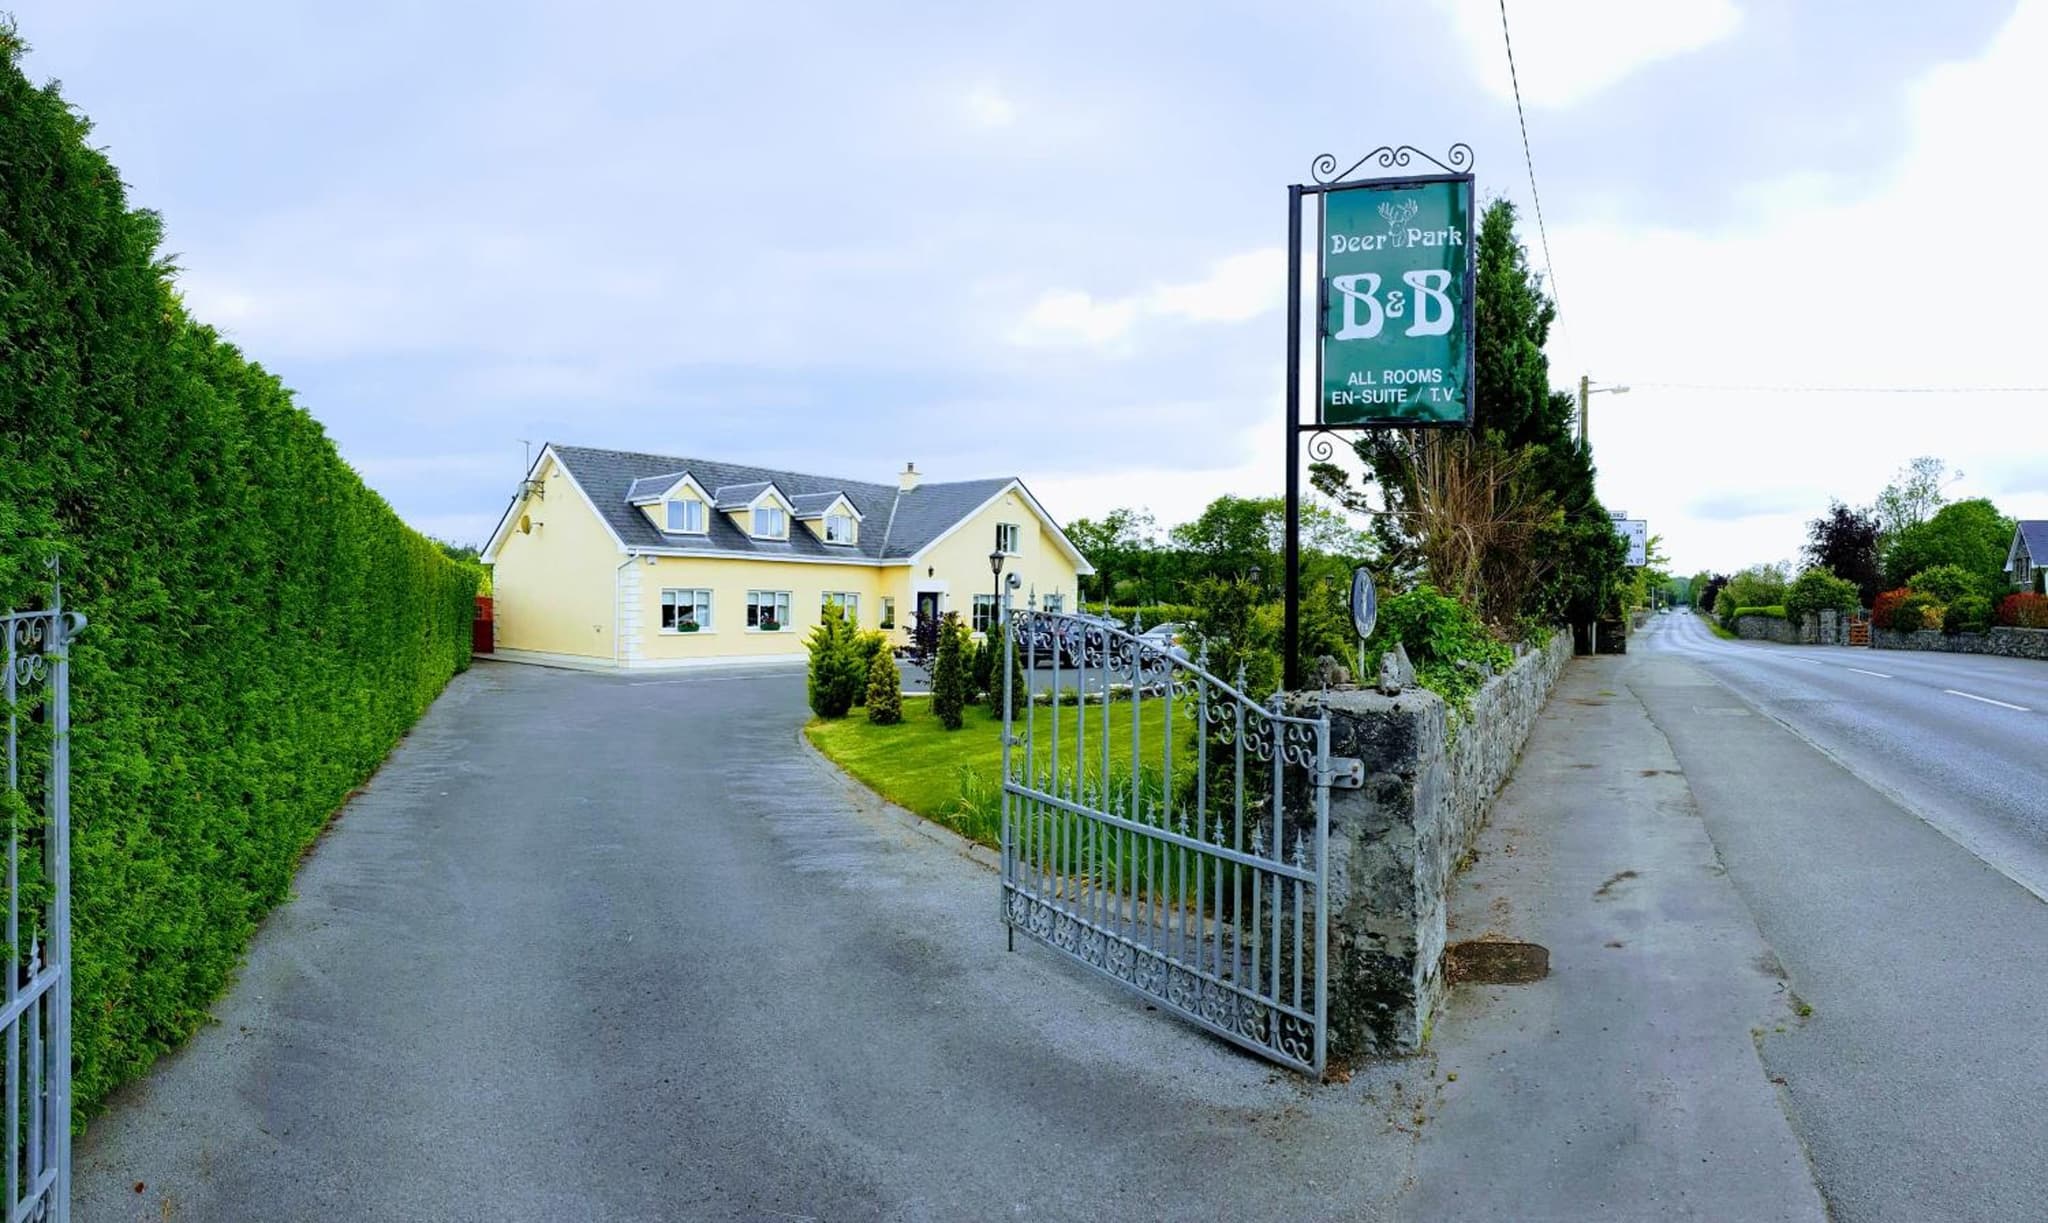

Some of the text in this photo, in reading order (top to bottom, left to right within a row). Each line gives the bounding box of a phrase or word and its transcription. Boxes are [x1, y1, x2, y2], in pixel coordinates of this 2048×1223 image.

[1331, 226, 1463, 254] Deer Park
[1332, 269, 1455, 341] B&B
[1347, 368, 1443, 386] ALL ROOMS
[1332, 388, 1408, 405] EN-SUITE
